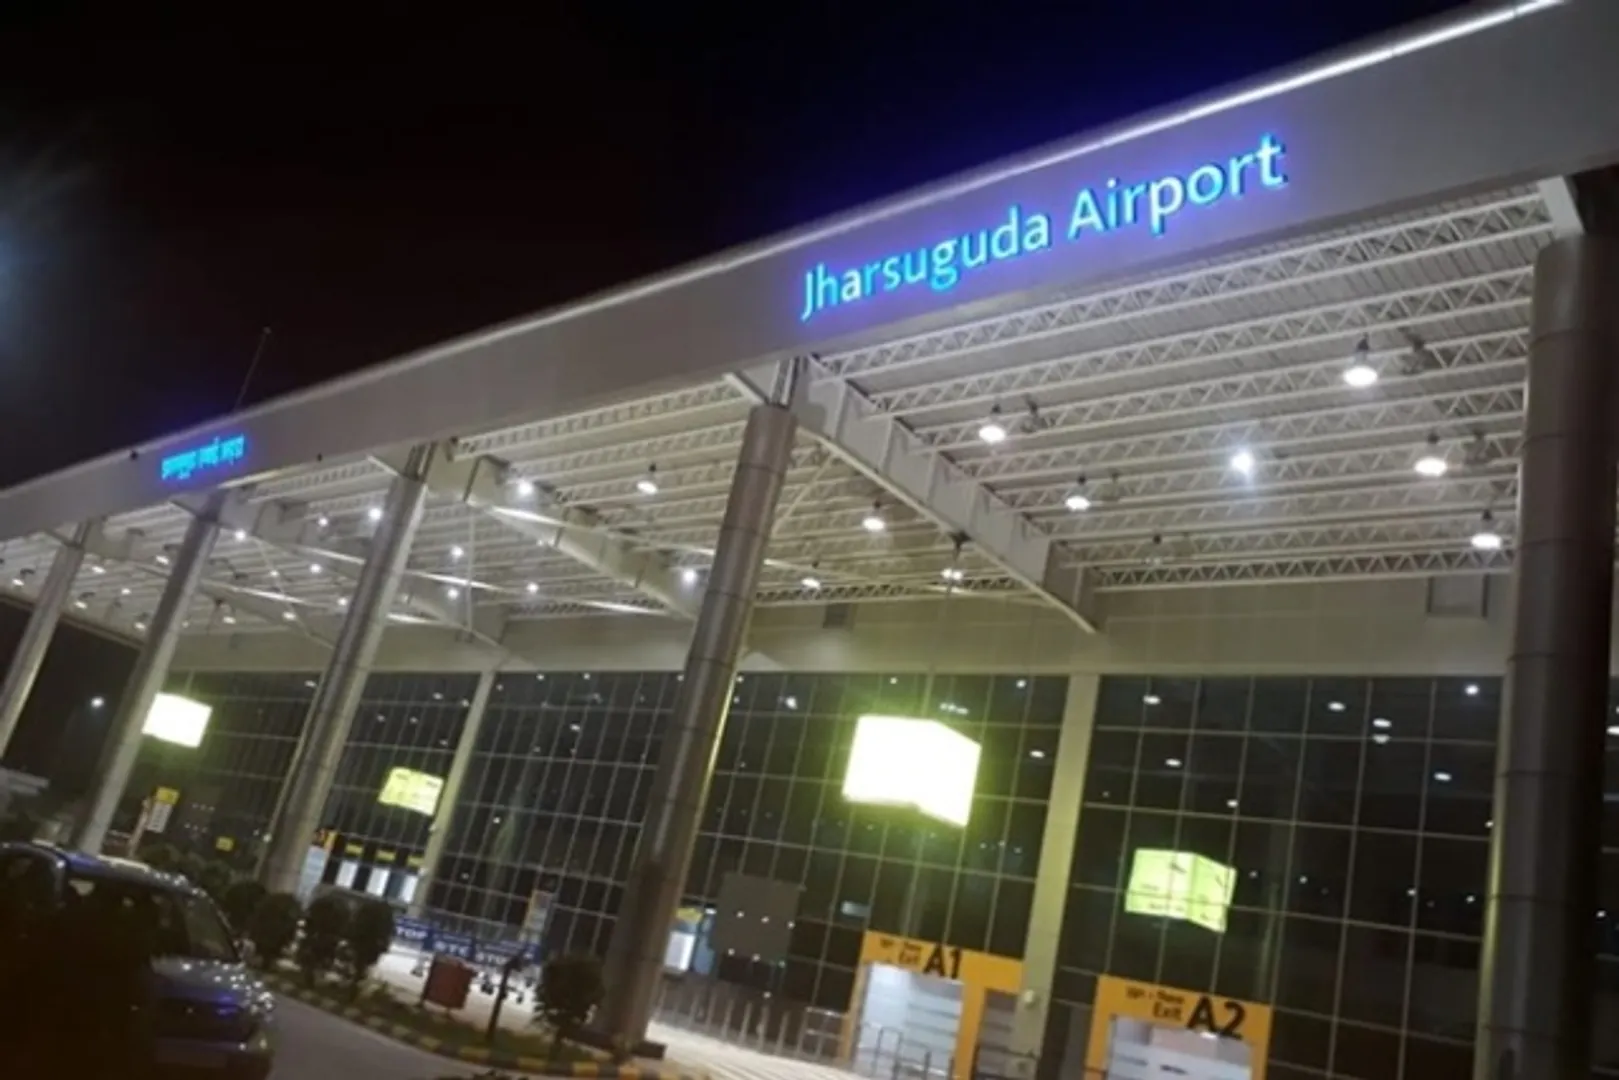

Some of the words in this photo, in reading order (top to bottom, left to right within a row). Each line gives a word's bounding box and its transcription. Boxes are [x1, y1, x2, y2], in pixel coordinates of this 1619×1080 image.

[801, 206, 1050, 321] Jharsuguda
[1067, 133, 1288, 236] Airport
[923, 944, 961, 980] A1
[1187, 995, 1245, 1040] A2
